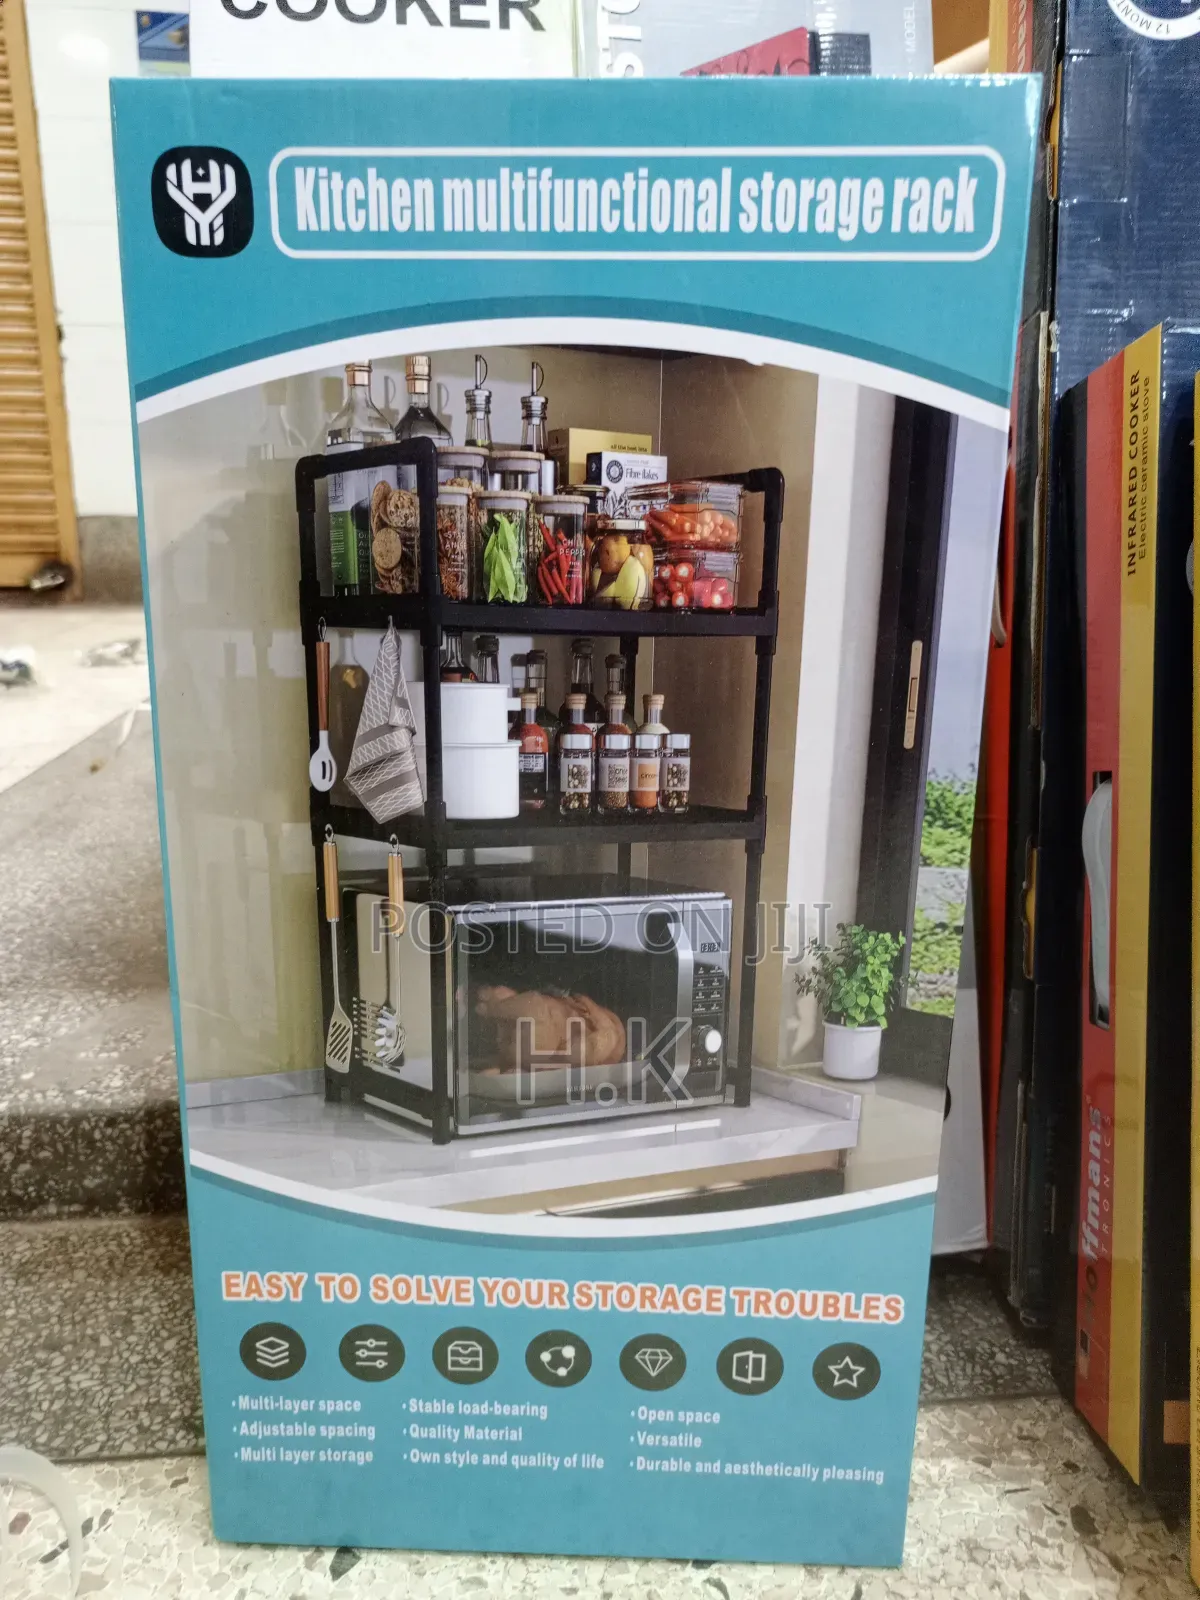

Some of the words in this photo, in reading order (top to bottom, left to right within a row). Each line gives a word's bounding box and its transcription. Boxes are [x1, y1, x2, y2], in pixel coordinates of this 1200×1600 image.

[294, 167, 435, 233] Kitchen
[443, 167, 732, 234] multifunctional
[738, 171, 885, 243] storage
[891, 165, 978, 235] rack
[1129, 369, 1141, 461] COOKER
[1140, 426, 1150, 493] ceramic
[1127, 464, 1139, 577] INFRARED
[1138, 496, 1149, 560] Electric
[221, 1271, 308, 1303] EASY
[315, 1272, 361, 1303] TO
[368, 1274, 476, 1307] SOLVE
[476, 1277, 569, 1310] YOUR
[573, 1280, 726, 1316] STORAGE
[728, 1287, 905, 1325] TROUBLES
[238, 1395, 316, 1414] Multi-layer
[318, 1398, 362, 1413] space
[408, 1398, 455, 1414] Stable
[458, 1399, 548, 1420] load-bearing
[637, 1405, 675, 1424] Open
[677, 1409, 721, 1425] space
[239, 1420, 317, 1438] Adjustable
[319, 1422, 376, 1440] spacing
[409, 1423, 461, 1443] Quality
[463, 1425, 523, 1441] Material
[637, 1431, 702, 1449] Versatile
[240, 1446, 277, 1462] Multi
[279, 1447, 316, 1464] layer
[318, 1448, 374, 1465] storage
[409, 1449, 441, 1464] Own
[443, 1449, 479, 1467] style
[481, 1450, 508, 1467] and
[510, 1451, 561, 1471] quality
[563, 1454, 578, 1469] of
[581, 1454, 605, 1470] life
[636, 1456, 692, 1474] Durable
[695, 1458, 721, 1474] and
[723, 1461, 820, 1483] aesthetically
[822, 1465, 885, 1485] pleasing
